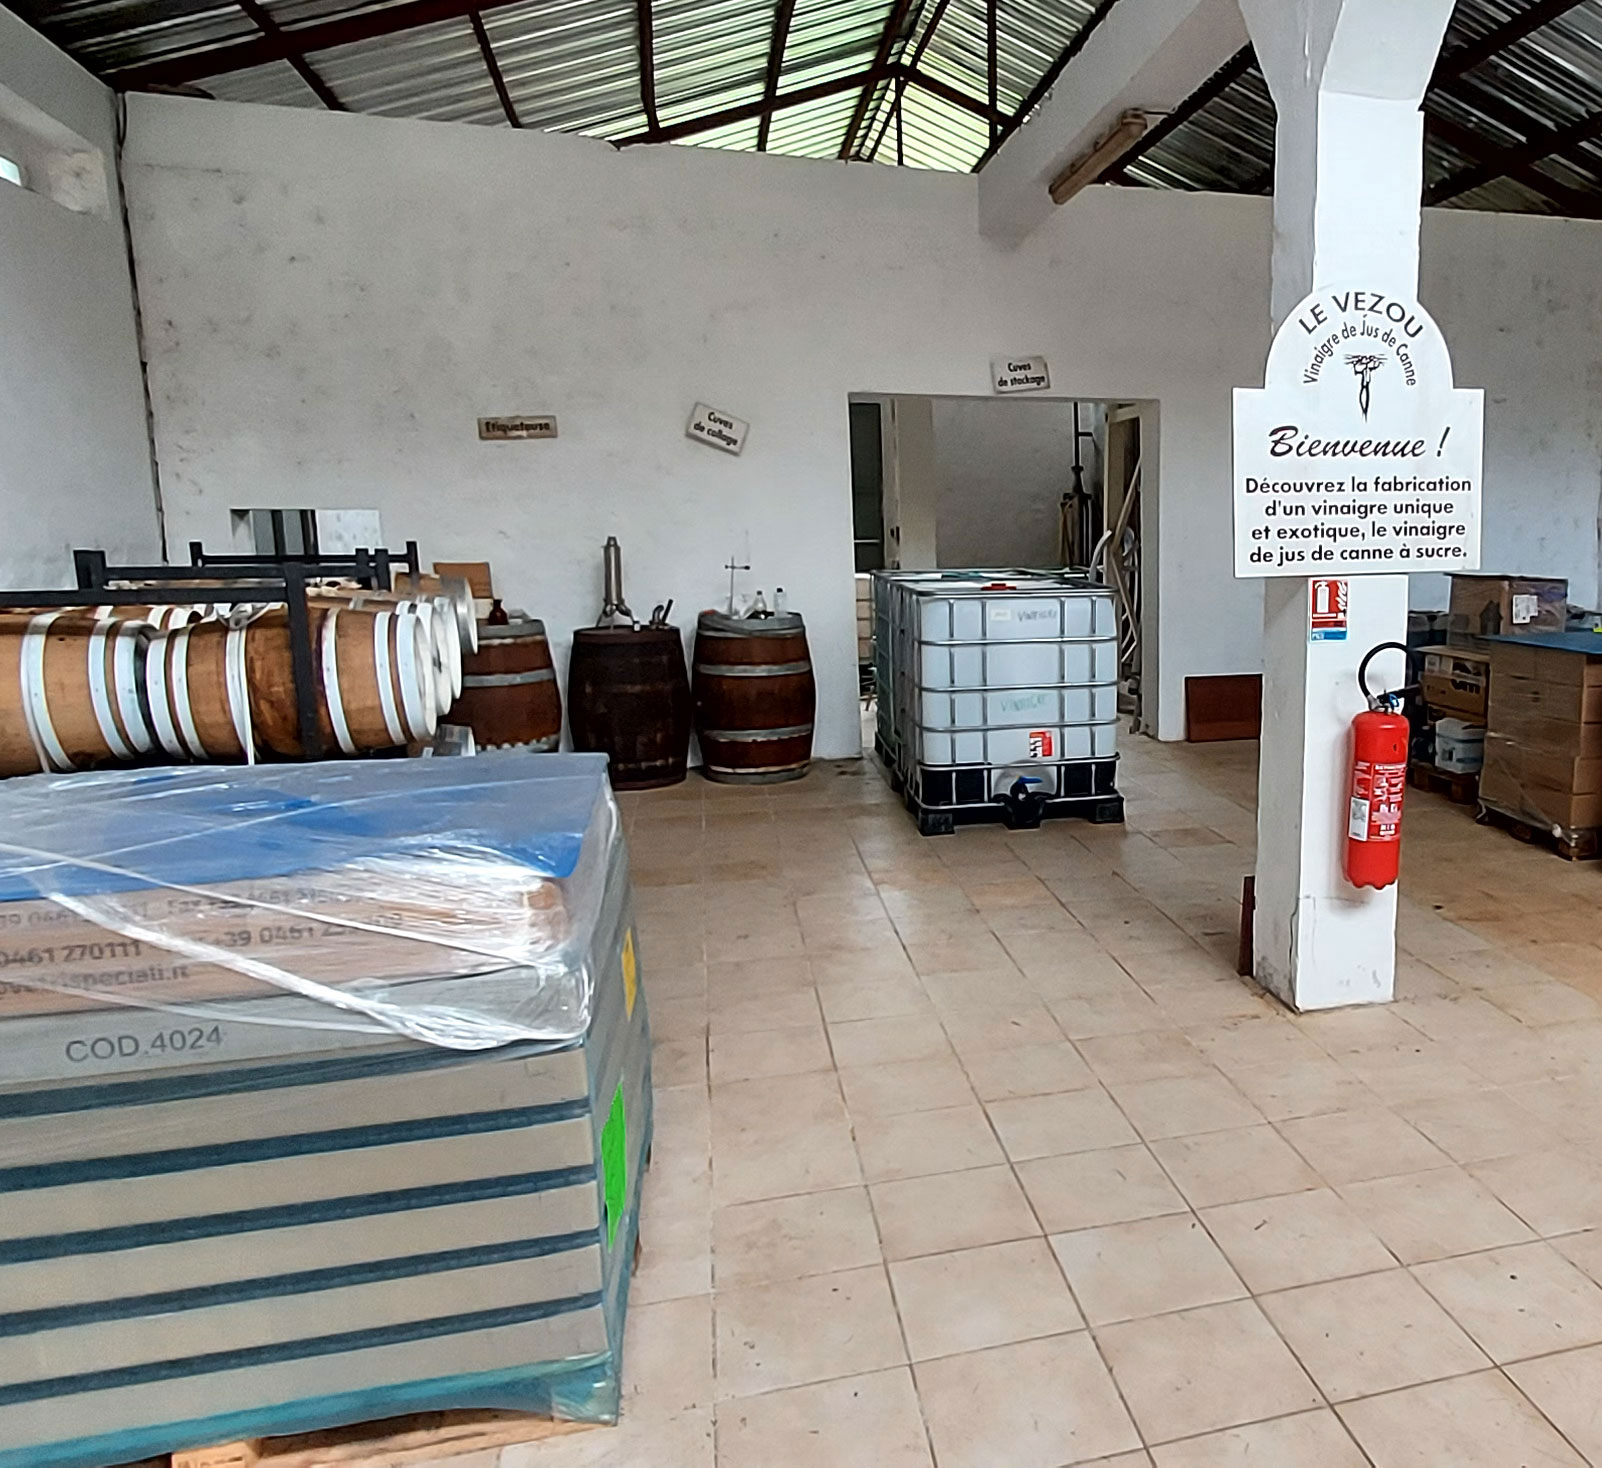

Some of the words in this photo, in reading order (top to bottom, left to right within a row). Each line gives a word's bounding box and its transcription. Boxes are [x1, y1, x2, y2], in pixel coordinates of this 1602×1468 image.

[1299, 303, 1328, 335] LE
[1331, 291, 1423, 338] VEZOU
[1303, 334, 1340, 384] Vinaigre
[1341, 321, 1357, 339] de
[1381, 328, 1397, 347] de
[1396, 343, 1416, 386] Canne
[1268, 425, 1426, 457] Bienvenue
[1436, 426, 1450, 457] !
[1245, 477, 1346, 493] Découvrez
[1351, 476, 1368, 492] la
[1374, 475, 1472, 492] fabrication
[1265, 500, 1305, 516] d'un
[1311, 499, 1388, 519] vinaigre
[1393, 498, 1454, 518] unique
[1251, 525, 1271, 540] et
[1276, 522, 1365, 543] exotique,
[1371, 521, 1387, 537] le
[1392, 521, 1466, 540] vinaigre
[1250, 547, 1273, 563] de
[1277, 547, 1305, 566] jus
[1311, 545, 1334, 560] de
[1340, 546, 1394, 560] canne
[1399, 544, 1411, 558] à
[1415, 545, 1467, 559] sucre.
[61, 941, 142, 963] 270111
